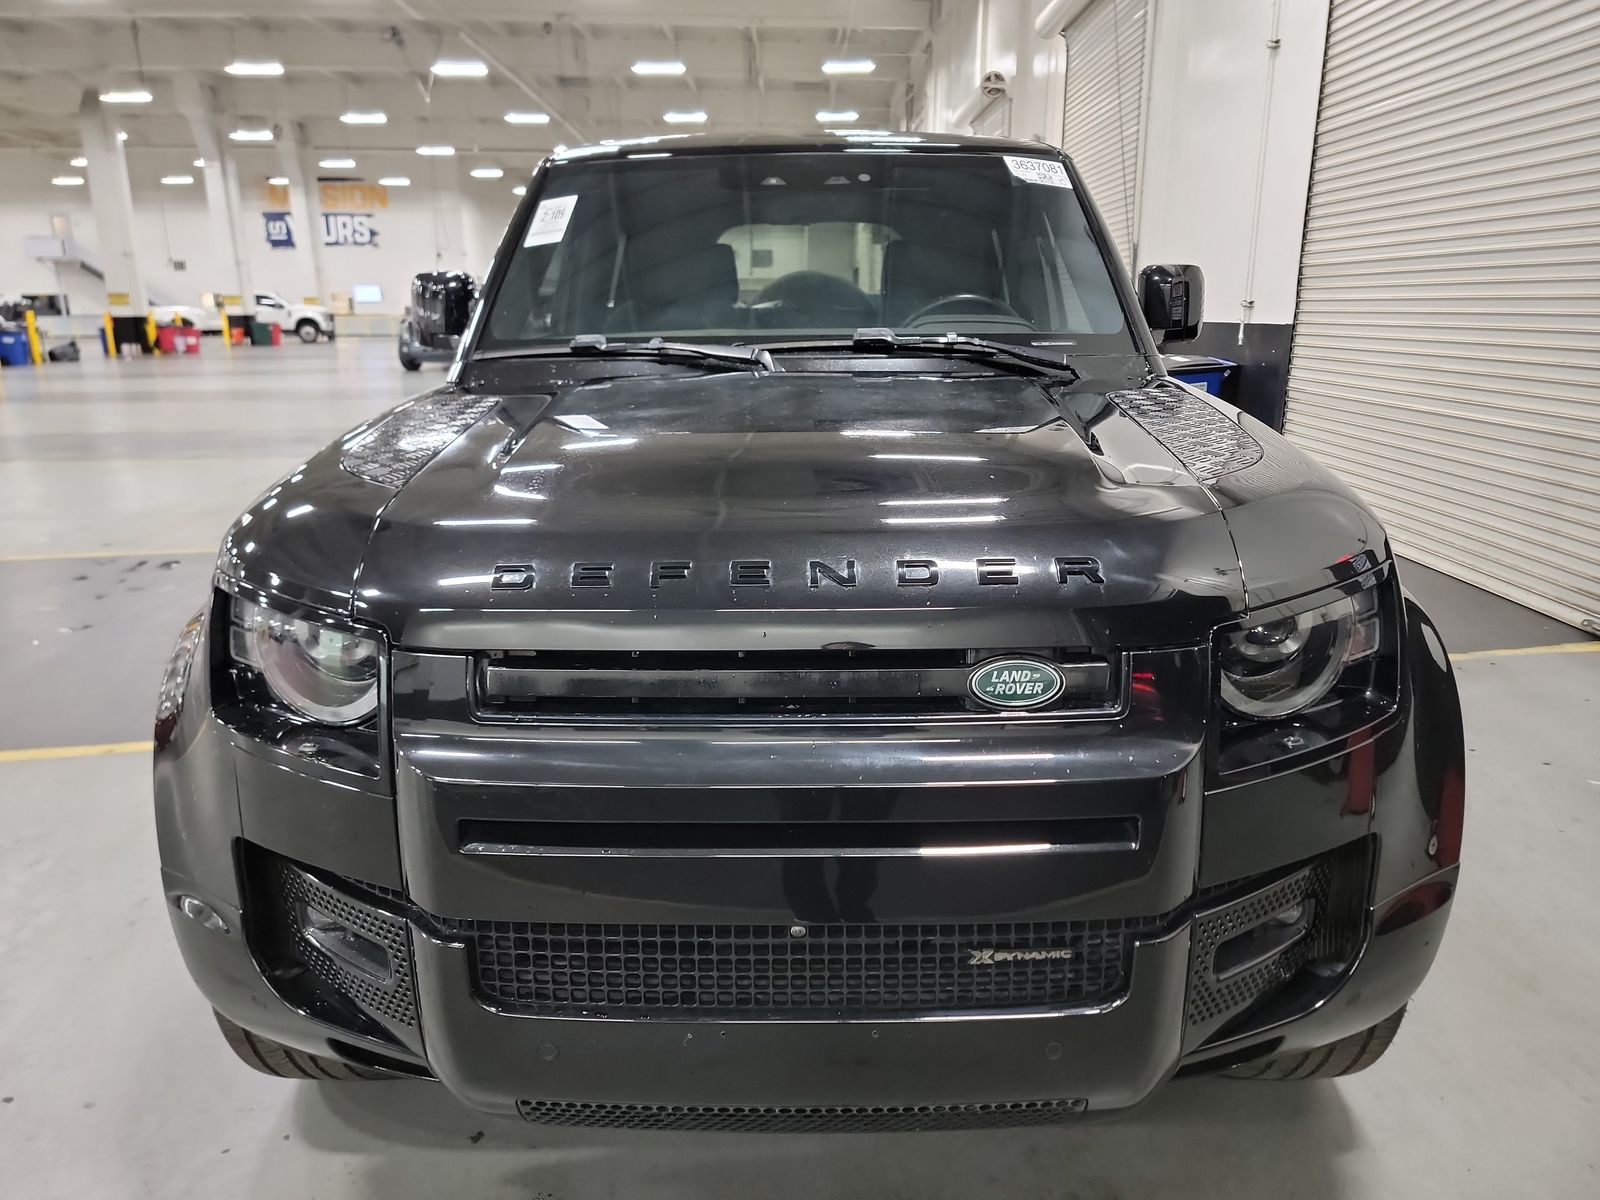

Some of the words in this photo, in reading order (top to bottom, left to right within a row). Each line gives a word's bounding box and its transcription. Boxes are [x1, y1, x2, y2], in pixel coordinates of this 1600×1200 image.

[1011, 159, 1064, 175] 3637081
[491, 556, 1105, 591] DEFENDER
[991, 670, 1031, 682] LAND
[994, 682, 1044, 695] ROVER
